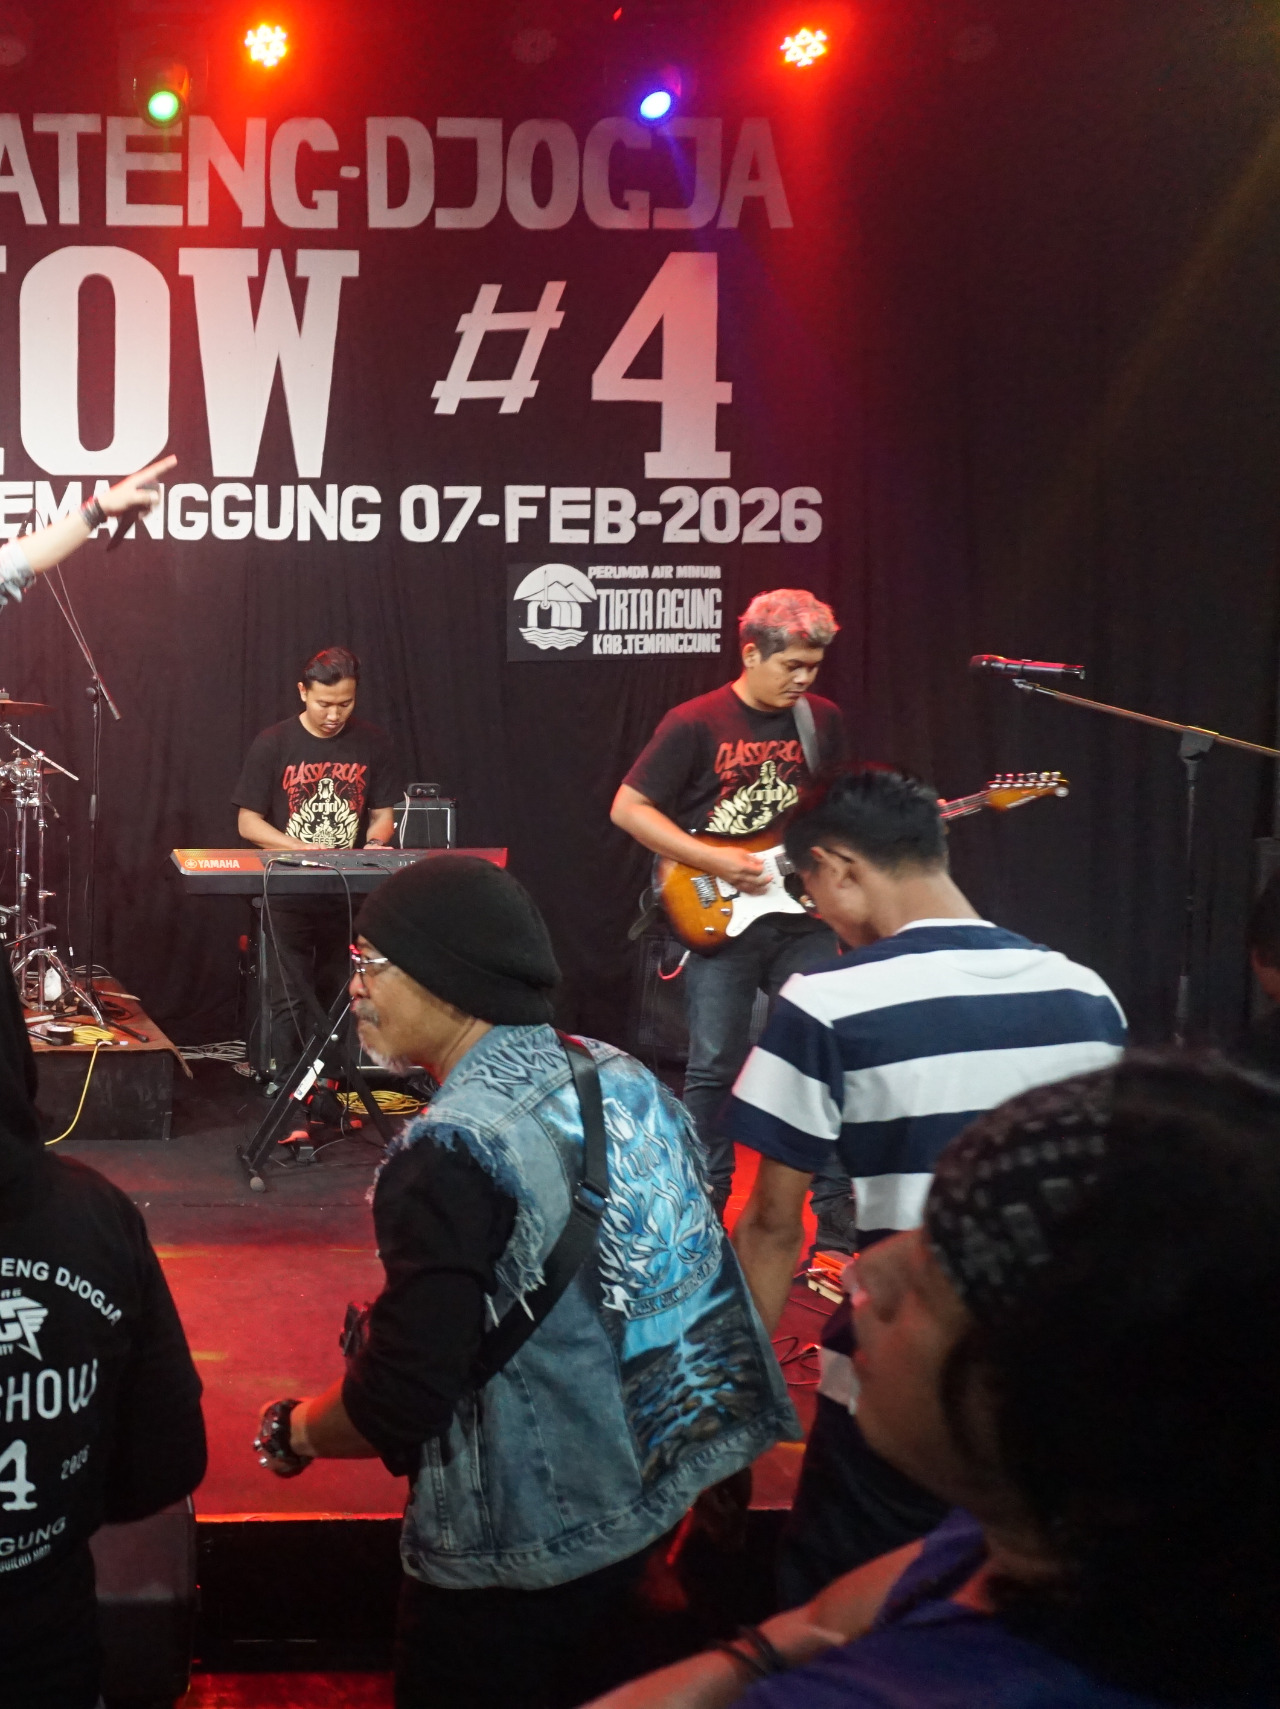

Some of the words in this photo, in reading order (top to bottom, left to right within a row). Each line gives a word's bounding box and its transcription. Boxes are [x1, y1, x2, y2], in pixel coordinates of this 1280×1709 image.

[400, 485, 823, 545] 07-FEB-2026
[588, 566, 649, 579] PERUMDA
[651, 566, 673, 579] AIR
[676, 566, 722, 579] MINUM
[597, 589, 653, 631] TIRTA
[656, 588, 723, 630] AGUNG
[197, 859, 240, 869] YAMAHA
[55, 1267, 123, 1327] DJOGJA
